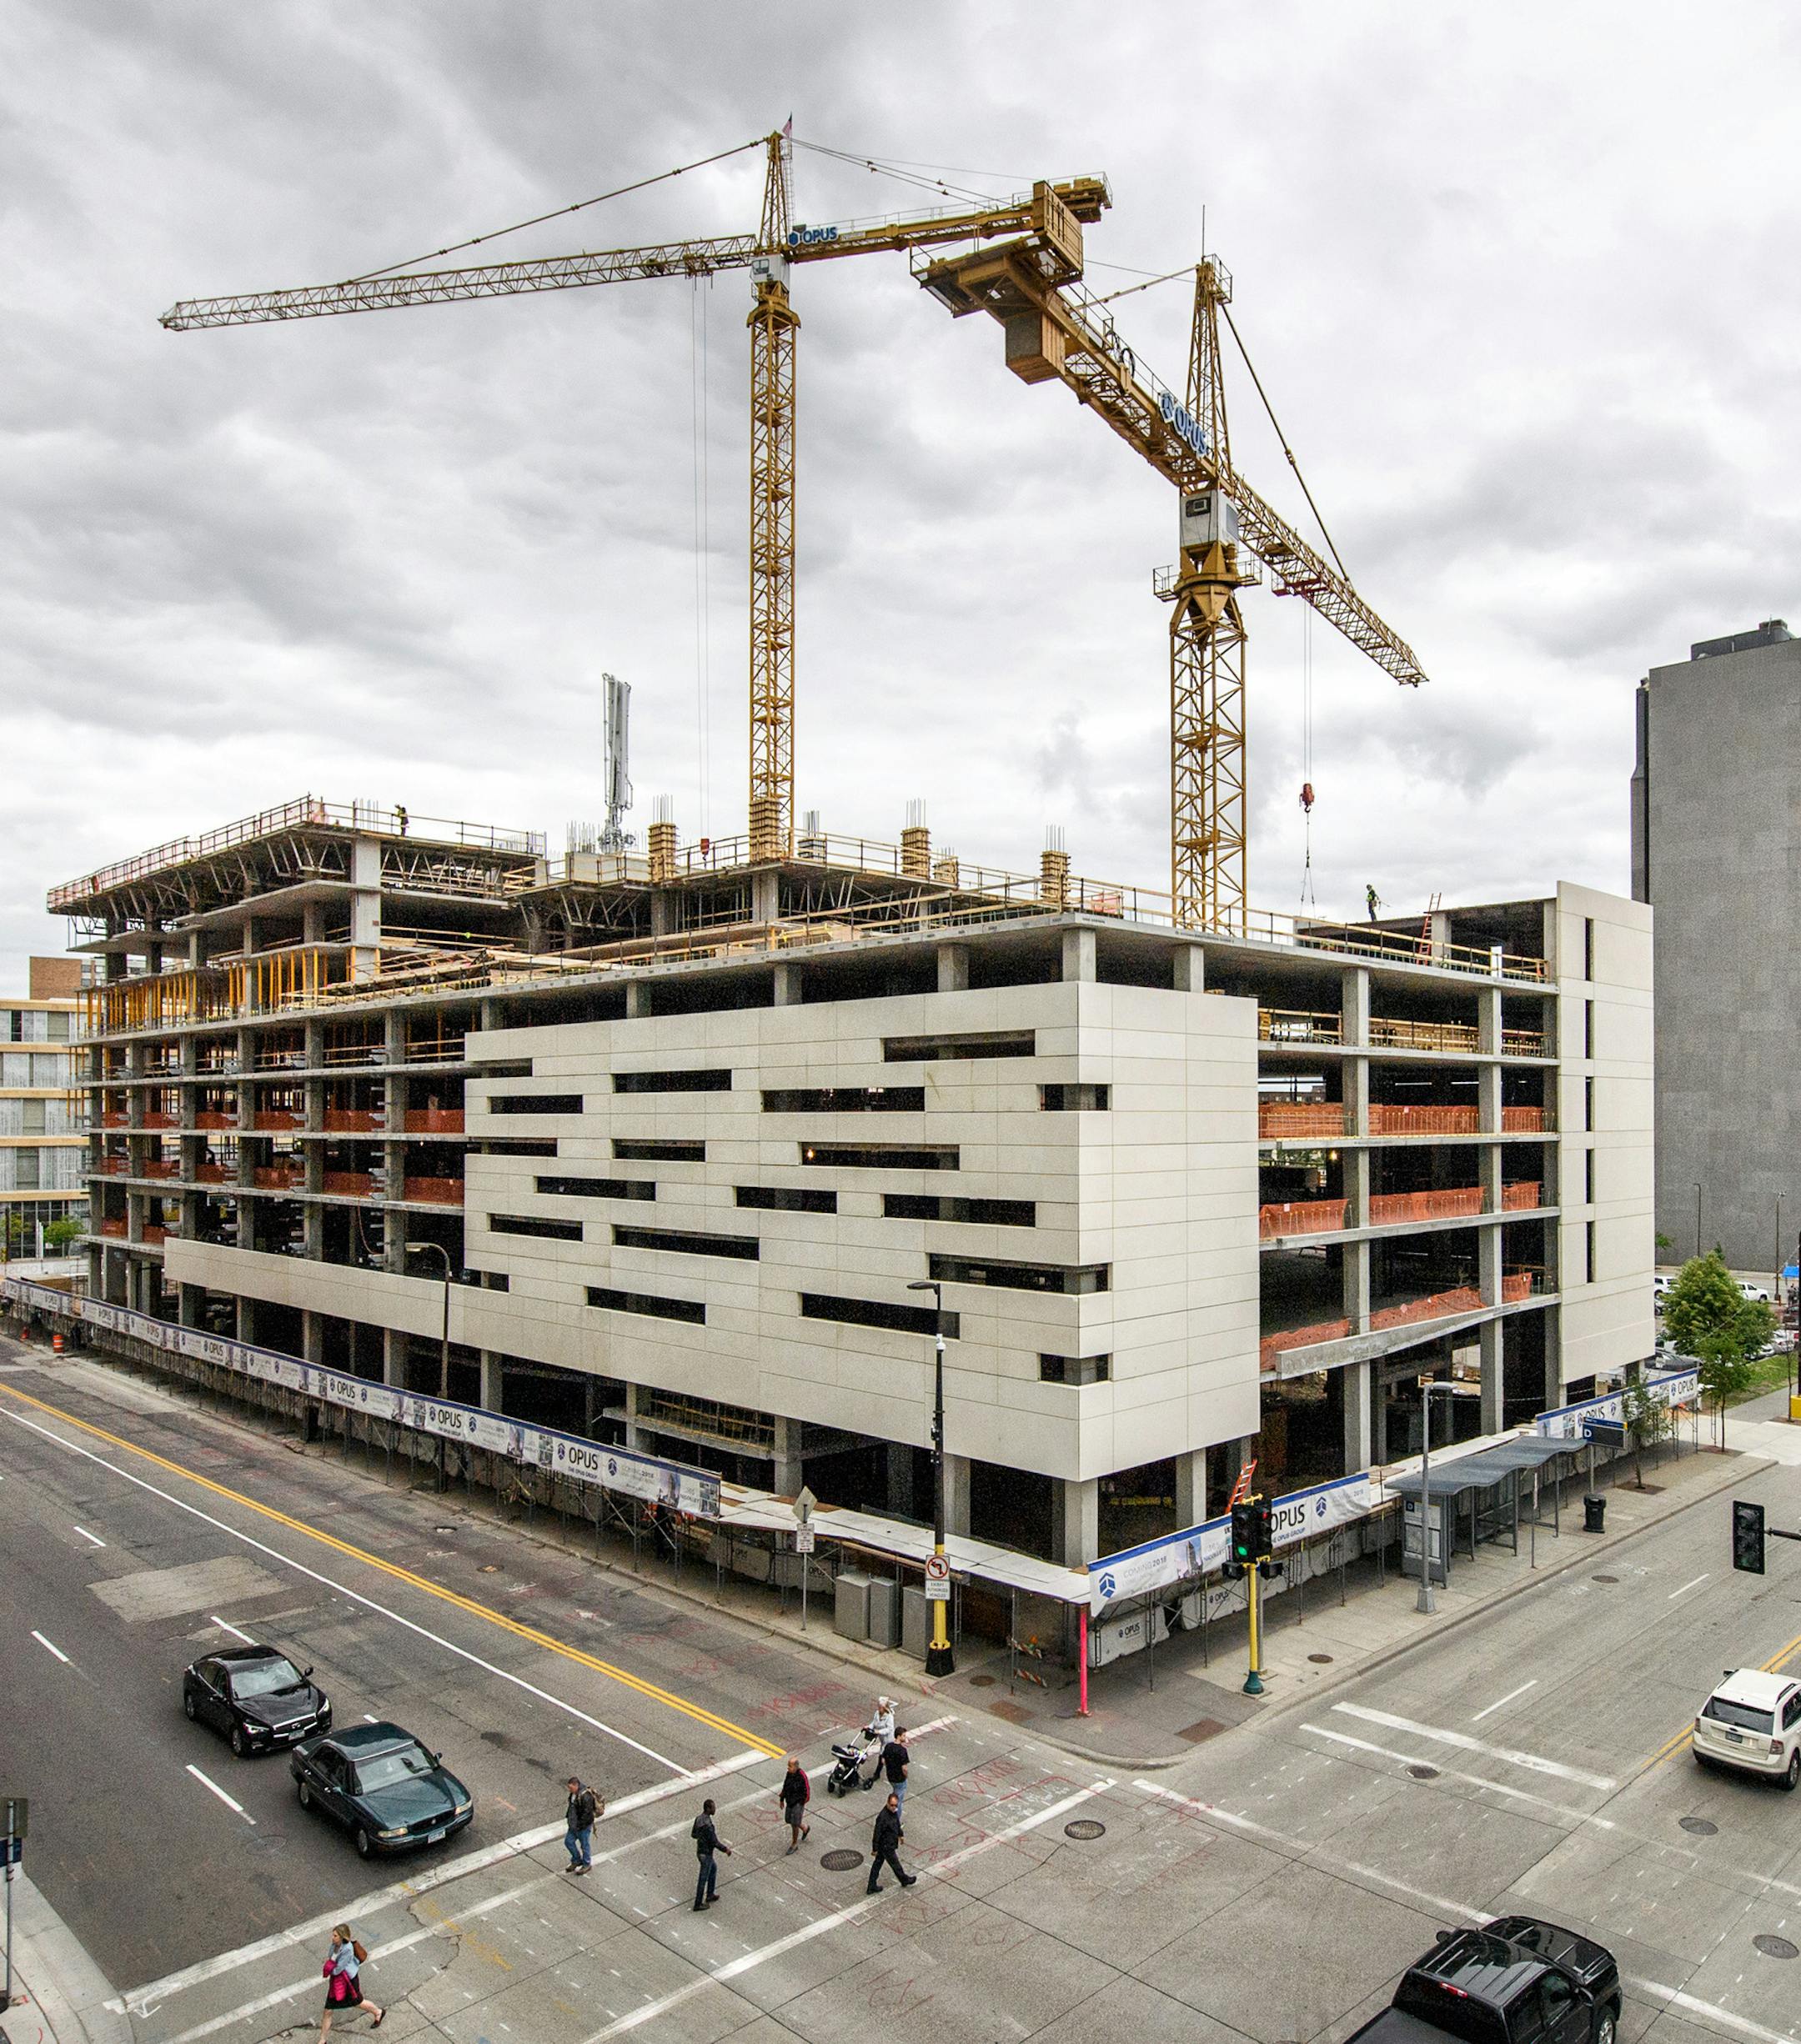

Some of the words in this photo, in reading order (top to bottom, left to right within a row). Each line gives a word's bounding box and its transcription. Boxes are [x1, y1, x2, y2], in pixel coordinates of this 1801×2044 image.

[803, 226, 838, 243] OPUS
[1174, 405, 1207, 455] OPUS
[208, 1341, 223, 1356] OPUS
[337, 1380, 355, 1399] OPUS
[1678, 1377, 1693, 1394] OPUS
[438, 1409, 462, 1429] OPUS
[1583, 1429, 1593, 1437] D
[569, 1446, 599, 1470] OPUS
[585, 1471, 598, 1480] GROUP
[1271, 1504, 1305, 1533] OPUS
[1277, 1532, 1290, 1542] OPUS
[1290, 1526, 1306, 1539] GROUP
[1214, 1591, 1229, 1602] OPUS
[1124, 1622, 1141, 1635] OPUS
